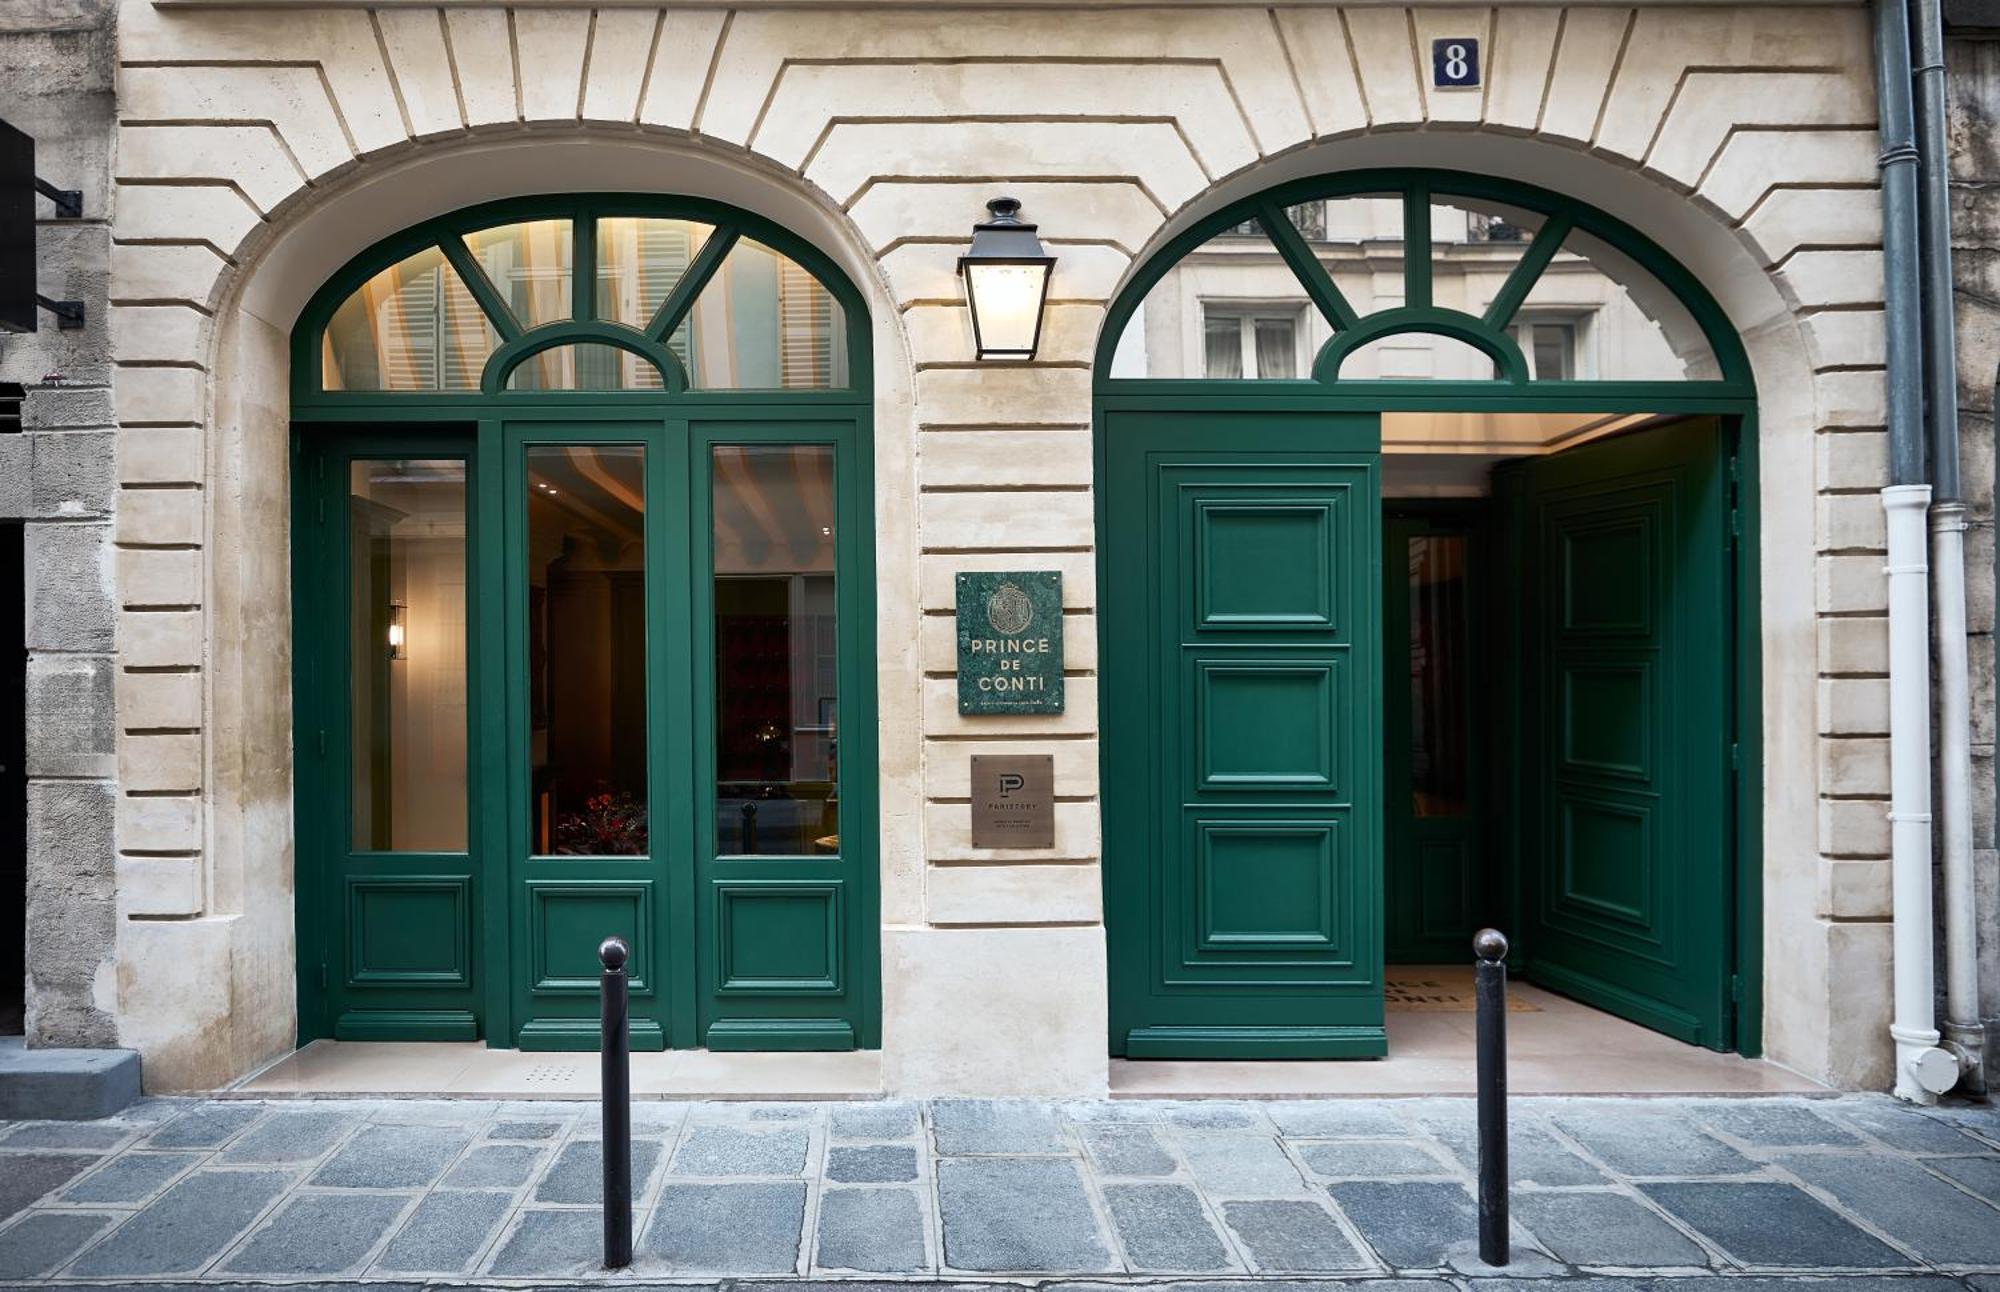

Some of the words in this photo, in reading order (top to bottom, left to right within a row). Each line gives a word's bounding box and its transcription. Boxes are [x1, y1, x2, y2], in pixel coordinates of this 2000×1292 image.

[1446, 44, 1468, 79] 8
[971, 639, 1049, 653] PRINCE
[1000, 660, 1021, 670] DE
[979, 677, 1044, 691] CONTI
